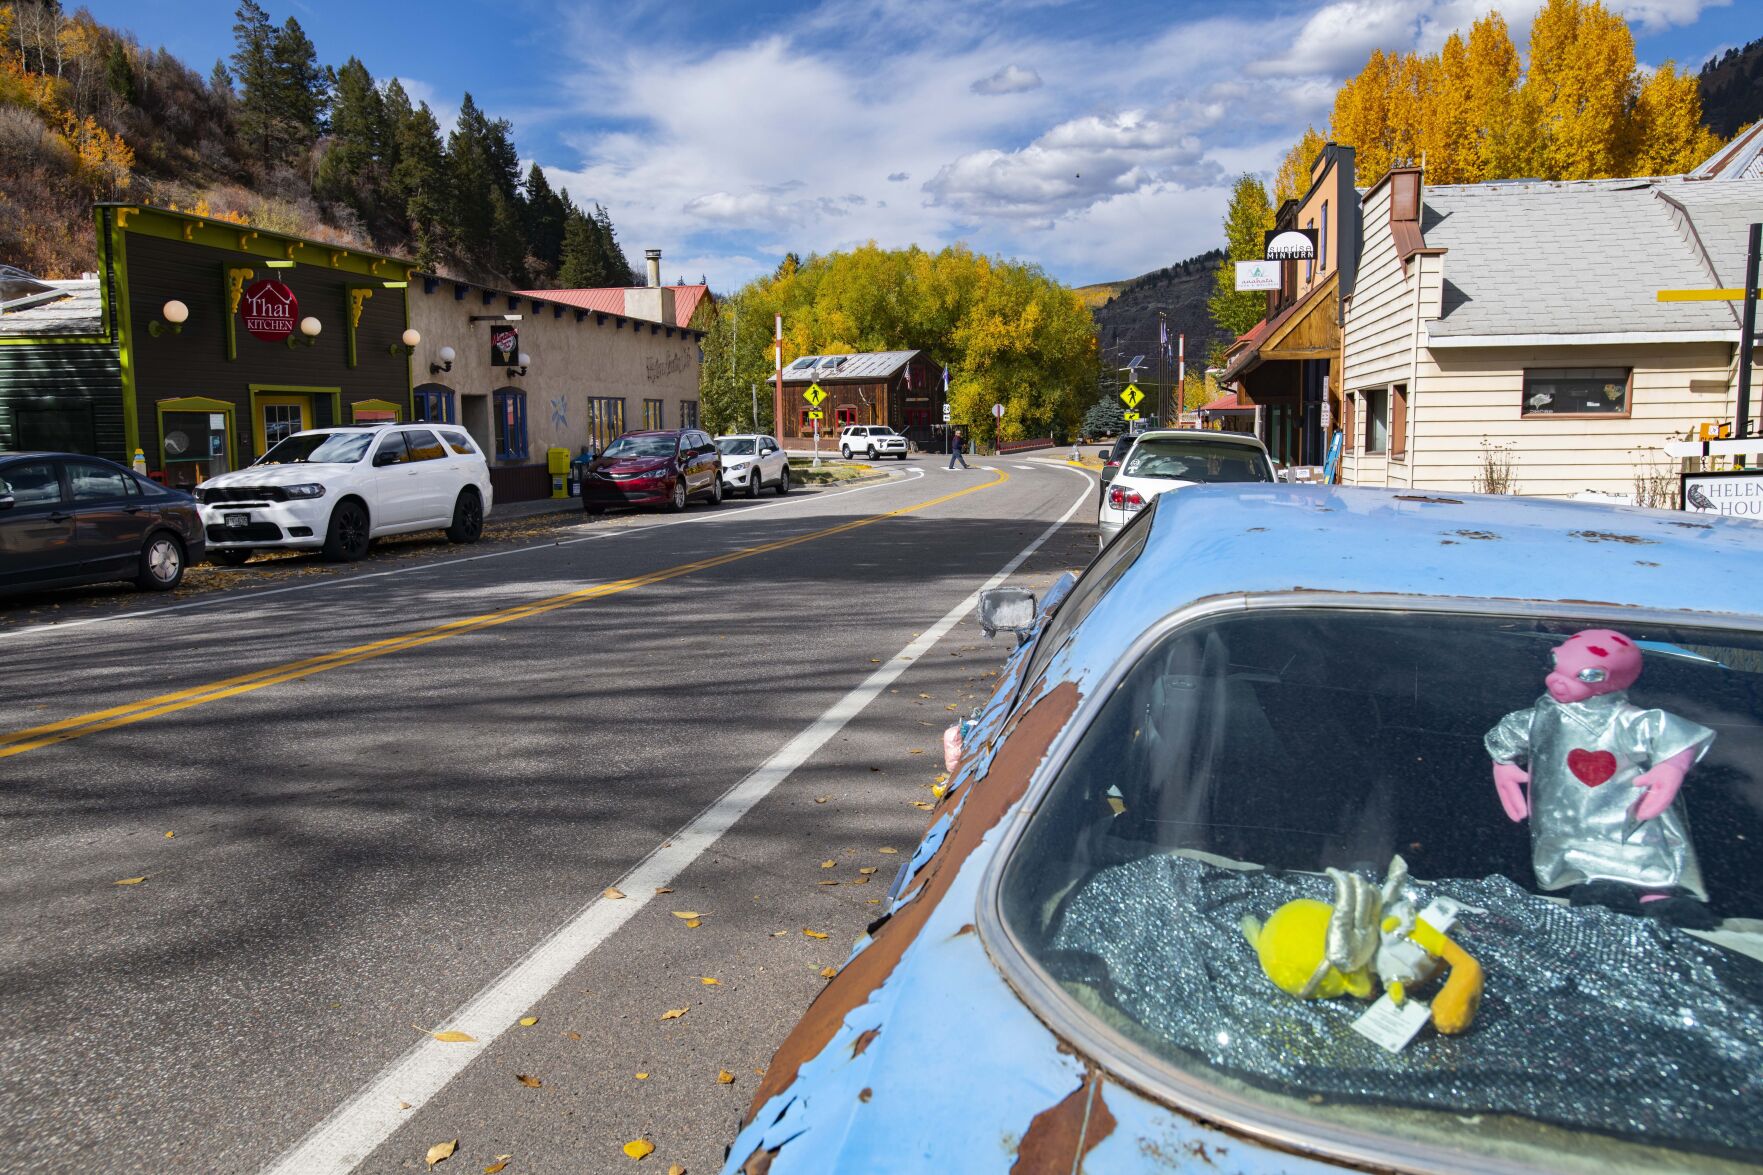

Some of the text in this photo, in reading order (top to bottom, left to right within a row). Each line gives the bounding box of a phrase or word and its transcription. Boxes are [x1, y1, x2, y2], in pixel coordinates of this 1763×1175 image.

[1269, 244, 1312, 253] sunrise
[1266, 250, 1314, 260] MINTURN
[249, 298, 291, 317] Thai
[247, 319, 293, 330] KITCHEN
